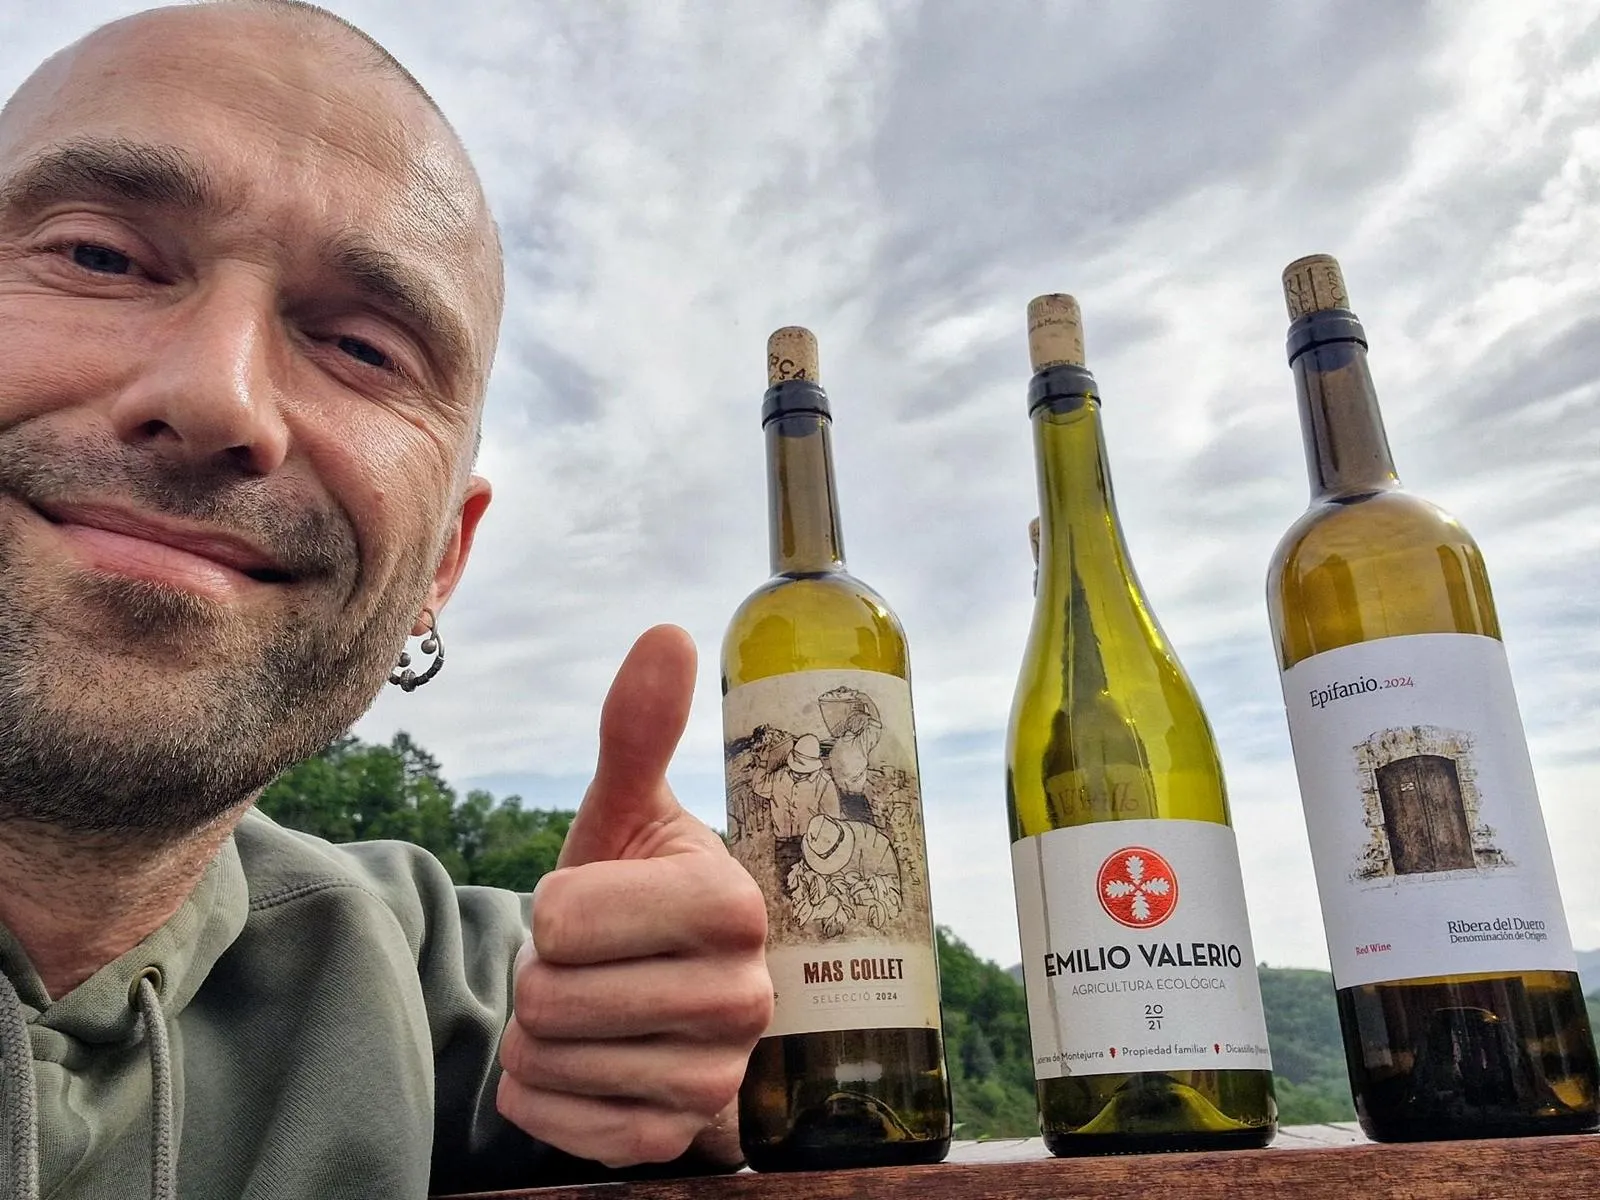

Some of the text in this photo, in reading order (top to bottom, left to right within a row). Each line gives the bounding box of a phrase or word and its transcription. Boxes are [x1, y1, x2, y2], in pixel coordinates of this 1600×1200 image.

[1384, 676, 1414, 689] 2024
[1447, 917, 1545, 934] Ribera del Duero
[1449, 931, 1514, 944] Denominación
[1515, 931, 1524, 940] de
[1355, 943, 1392, 956] Red Wine
[1044, 943, 1242, 977] EMILIO VALERIO
[803, 958, 904, 984] MAS COLLET
[1071, 975, 1226, 996] AGRICULTURA ECOLÓGICA
[812, 991, 898, 1005] SELECCIÓ 2024
[1144, 1004, 1163, 1015] 20
[1148, 1020, 1162, 1030] 21
[1061, 1050, 1104, 1061] Montejurra
[1122, 1043, 1208, 1058] Propiedad familiar
